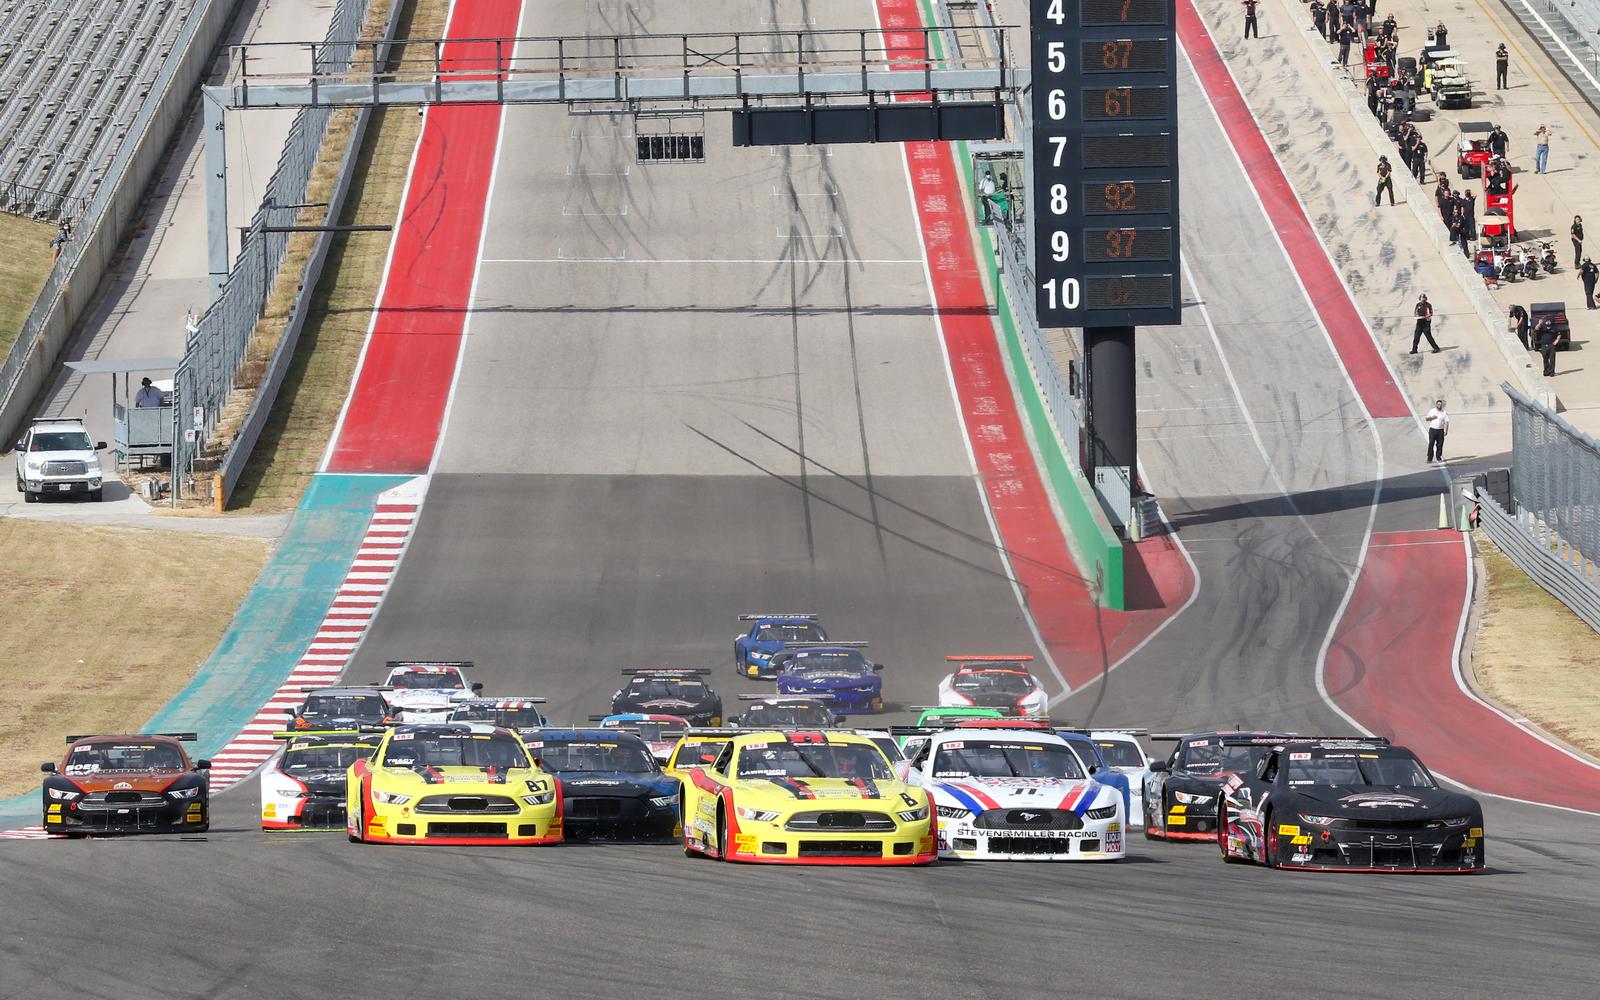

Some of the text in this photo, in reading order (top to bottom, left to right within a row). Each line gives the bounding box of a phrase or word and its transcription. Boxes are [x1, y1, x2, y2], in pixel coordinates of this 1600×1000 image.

[1046, 0, 1065, 25] 4
[1047, 42, 1066, 73] 5
[1103, 41, 1133, 69] 87
[1048, 89, 1067, 120] 6
[1105, 88, 1132, 116] 61
[1049, 136, 1067, 168] 7
[1050, 183, 1069, 215] 8
[1105, 183, 1136, 210] 92
[1051, 230, 1070, 262] 9
[1106, 230, 1136, 257] 37
[1042, 278, 1081, 310] 10
[525, 779, 548, 793] 87
[899, 792, 919, 807] 8
